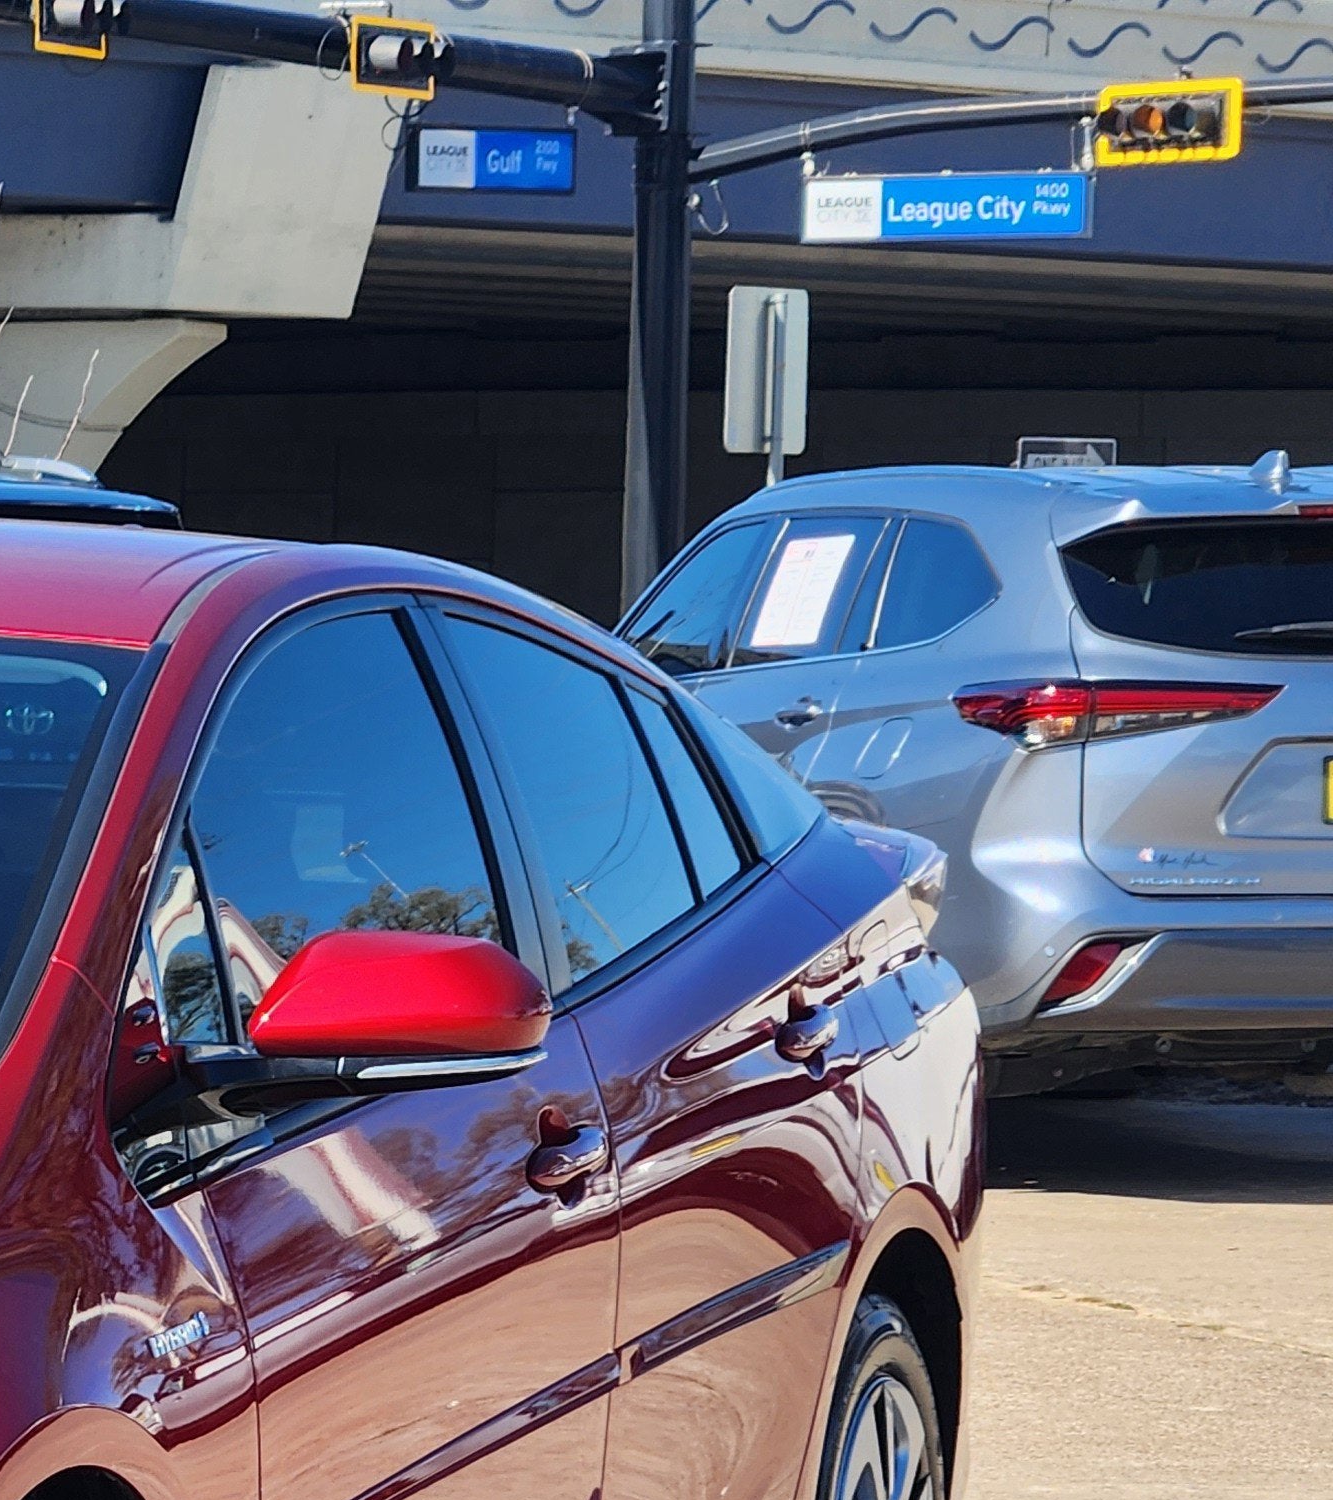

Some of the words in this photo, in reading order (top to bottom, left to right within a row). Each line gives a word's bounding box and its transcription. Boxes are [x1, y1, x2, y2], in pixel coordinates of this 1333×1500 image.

[427, 145, 469, 157] LEAGUE
[486, 148, 523, 174] Gulf
[535, 157, 559, 174] Fwy
[1035, 182, 1069, 198] 1400
[817, 196, 873, 209] LEAGUE
[1033, 200, 1071, 217] Pkwy
[886, 197, 972, 228] League
[977, 195, 1027, 225] City
